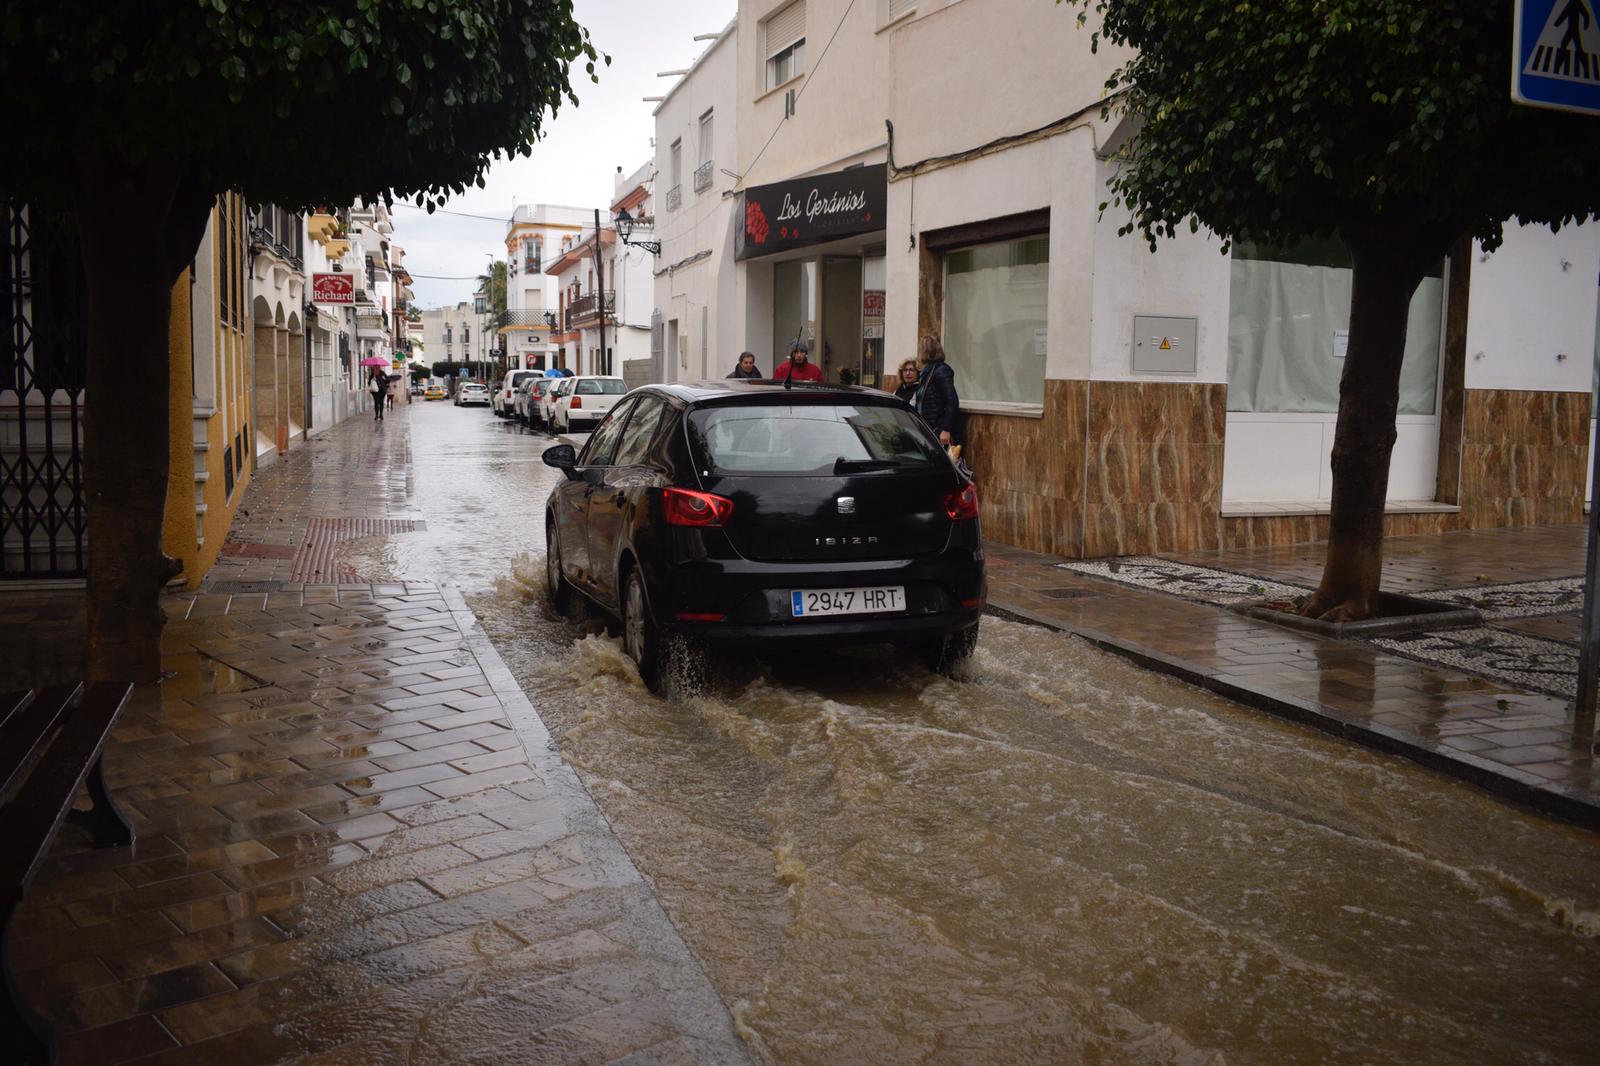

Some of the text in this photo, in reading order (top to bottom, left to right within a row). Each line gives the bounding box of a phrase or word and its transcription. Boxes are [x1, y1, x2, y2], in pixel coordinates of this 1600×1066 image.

[777, 192, 802, 221] Los
[313, 290, 353, 301] Richard
[815, 536, 879, 546] IBIZA
[807, 589, 897, 613] 2947 HRT
